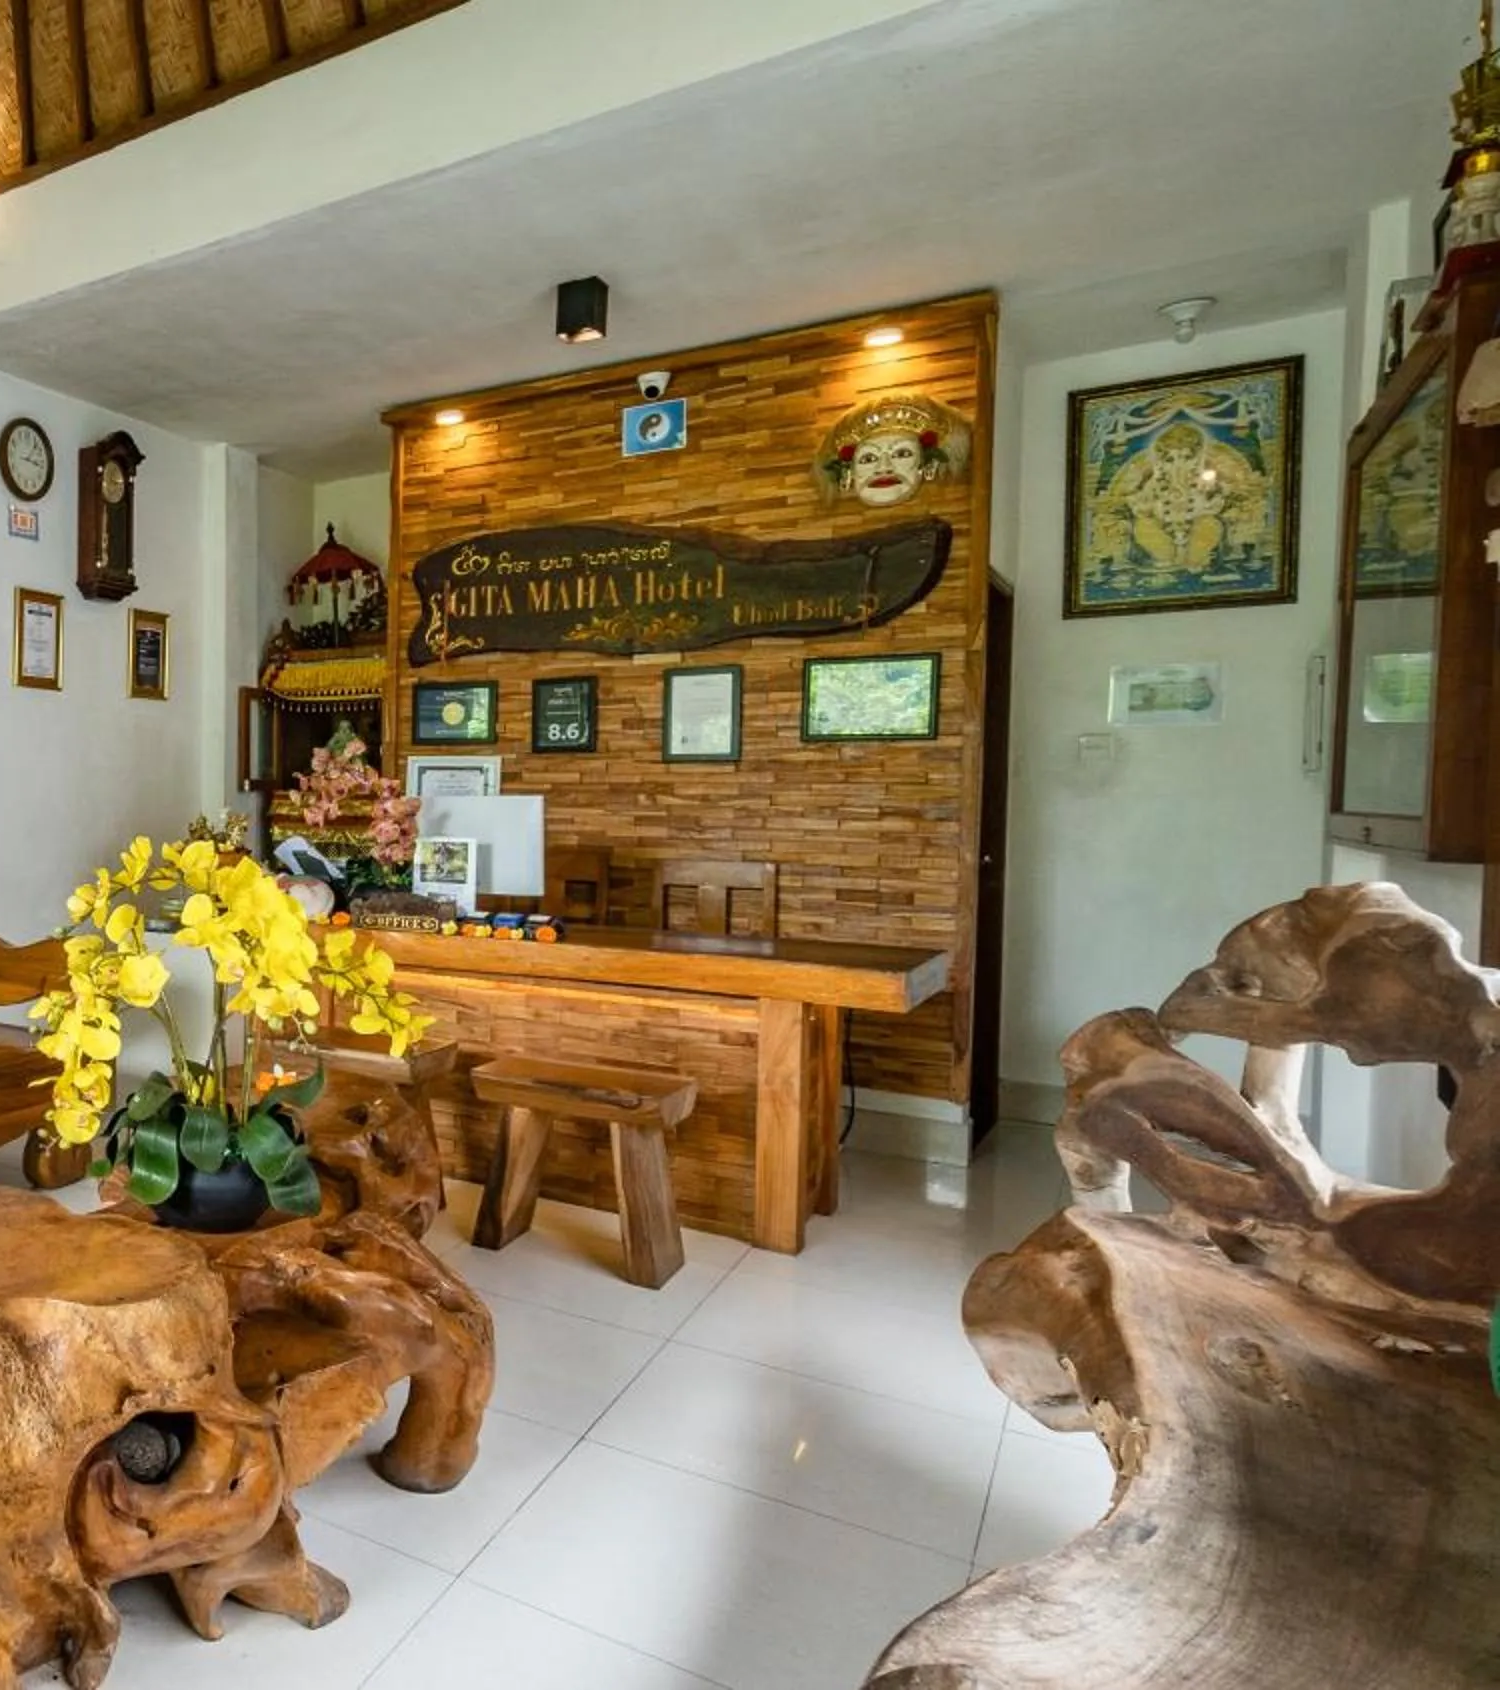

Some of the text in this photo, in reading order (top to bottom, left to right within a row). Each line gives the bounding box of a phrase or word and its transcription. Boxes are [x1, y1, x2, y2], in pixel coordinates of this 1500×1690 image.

[450, 564, 724, 617] GITA MAHA Hotel
[796, 595, 844, 621] Bali
[547, 723, 580, 741] 8.6
[377, 916, 421, 930] OFFICE
